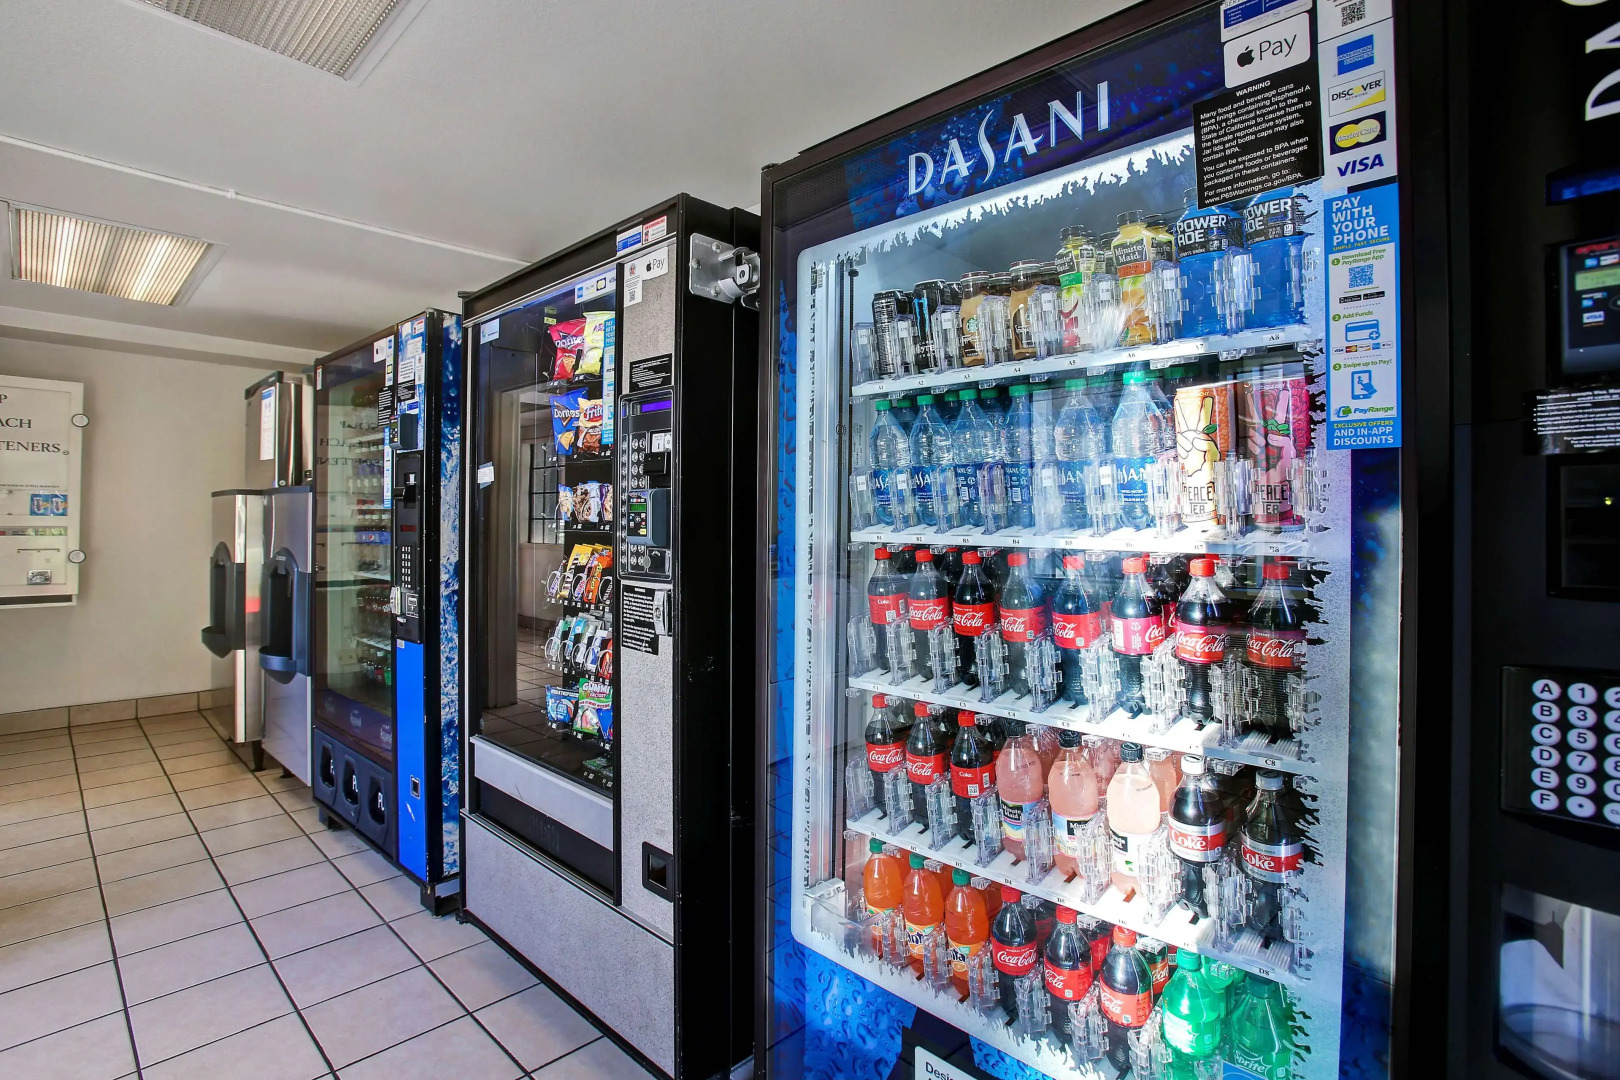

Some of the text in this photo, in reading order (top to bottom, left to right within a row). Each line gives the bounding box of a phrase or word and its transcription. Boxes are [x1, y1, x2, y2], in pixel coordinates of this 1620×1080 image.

[1259, 34, 1296, 60] Pay
[1236, 80, 1271, 97] WARNING
[1200, 84, 1294, 120] Many food and beverage cans
[1200, 118, 1216, 127] have
[1237, 99, 1271, 115] containing
[1271, 88, 1304, 102] bisphenol
[1304, 84, 1311, 92] A
[1227, 111, 1255, 125] chemical
[1256, 105, 1278, 116] known
[1287, 97, 1298, 106] the
[1201, 132, 1218, 141] State
[1226, 120, 1256, 134] California
[1264, 110, 1285, 120] cause
[1285, 103, 1304, 113] harm
[908, 81, 1111, 196] DASANI
[1201, 140, 1212, 148] the
[1212, 134, 1234, 145] female
[1234, 121, 1274, 138] reproductive
[1213, 143, 1224, 152] lids
[1225, 140, 1237, 149] and
[1237, 135, 1256, 145] bottle
[1256, 130, 1273, 139] caps
[1274, 123, 1289, 133] may
[1289, 118, 1305, 128] also
[1202, 151, 1225, 162] contain
[1203, 163, 1215, 173] You
[1238, 148, 1266, 163] exposed
[1274, 142, 1290, 151] BPA
[1289, 136, 1309, 146] when
[1203, 173, 1215, 181] you
[1215, 163, 1245, 176] consume
[1245, 158, 1263, 168] foods
[1272, 144, 1308, 159] beverages
[1337, 153, 1385, 177] VISA
[1203, 174, 1234, 188] packaged
[1241, 166, 1260, 176] these
[1216, 185, 1232, 193] more
[1332, 196, 1361, 212] PAY
[1332, 205, 1373, 223] WITH
[1176, 214, 1227, 234] POWER
[1332, 216, 1376, 234] YOUR
[1177, 229, 1205, 247] ADE
[1333, 225, 1389, 246] PHONE
[1114, 245, 1143, 257] Minute
[1119, 252, 1140, 263] Maid
[1342, 251, 1372, 260] Download
[652, 258, 665, 270] Pay
[1342, 257, 1371, 266] PayRange
[1342, 312, 1354, 320] Add
[1355, 310, 1374, 318] Funds
[554, 408, 580, 418] Doritos
[1353, 406, 1394, 415] PayRange
[1334, 421, 1367, 429] EXCLUSIVE
[1334, 426, 1393, 437] AND IN-APP
[1334, 435, 1394, 446] DISCOUNTS
[1176, 631, 1226, 652] Coca-Cola
[1246, 634, 1297, 657] Coca-Cola
[1540, 683, 1586, 698] A 1
[1540, 705, 1588, 721] B 3
[1539, 727, 1587, 744] C 5
[870, 748, 903, 764] Coca-Cola
[1265, 759, 1276, 767] C8
[1539, 749, 1587, 766] D 7
[1540, 771, 1587, 789] E 9
[1540, 793, 1552, 805] F
[1171, 829, 1207, 850] Coke
[1241, 844, 1275, 871] Coke
[997, 949, 1037, 967] Coca-Cola
[1258, 968, 1270, 976] D8
[1235, 1051, 1267, 1073] Sprite
